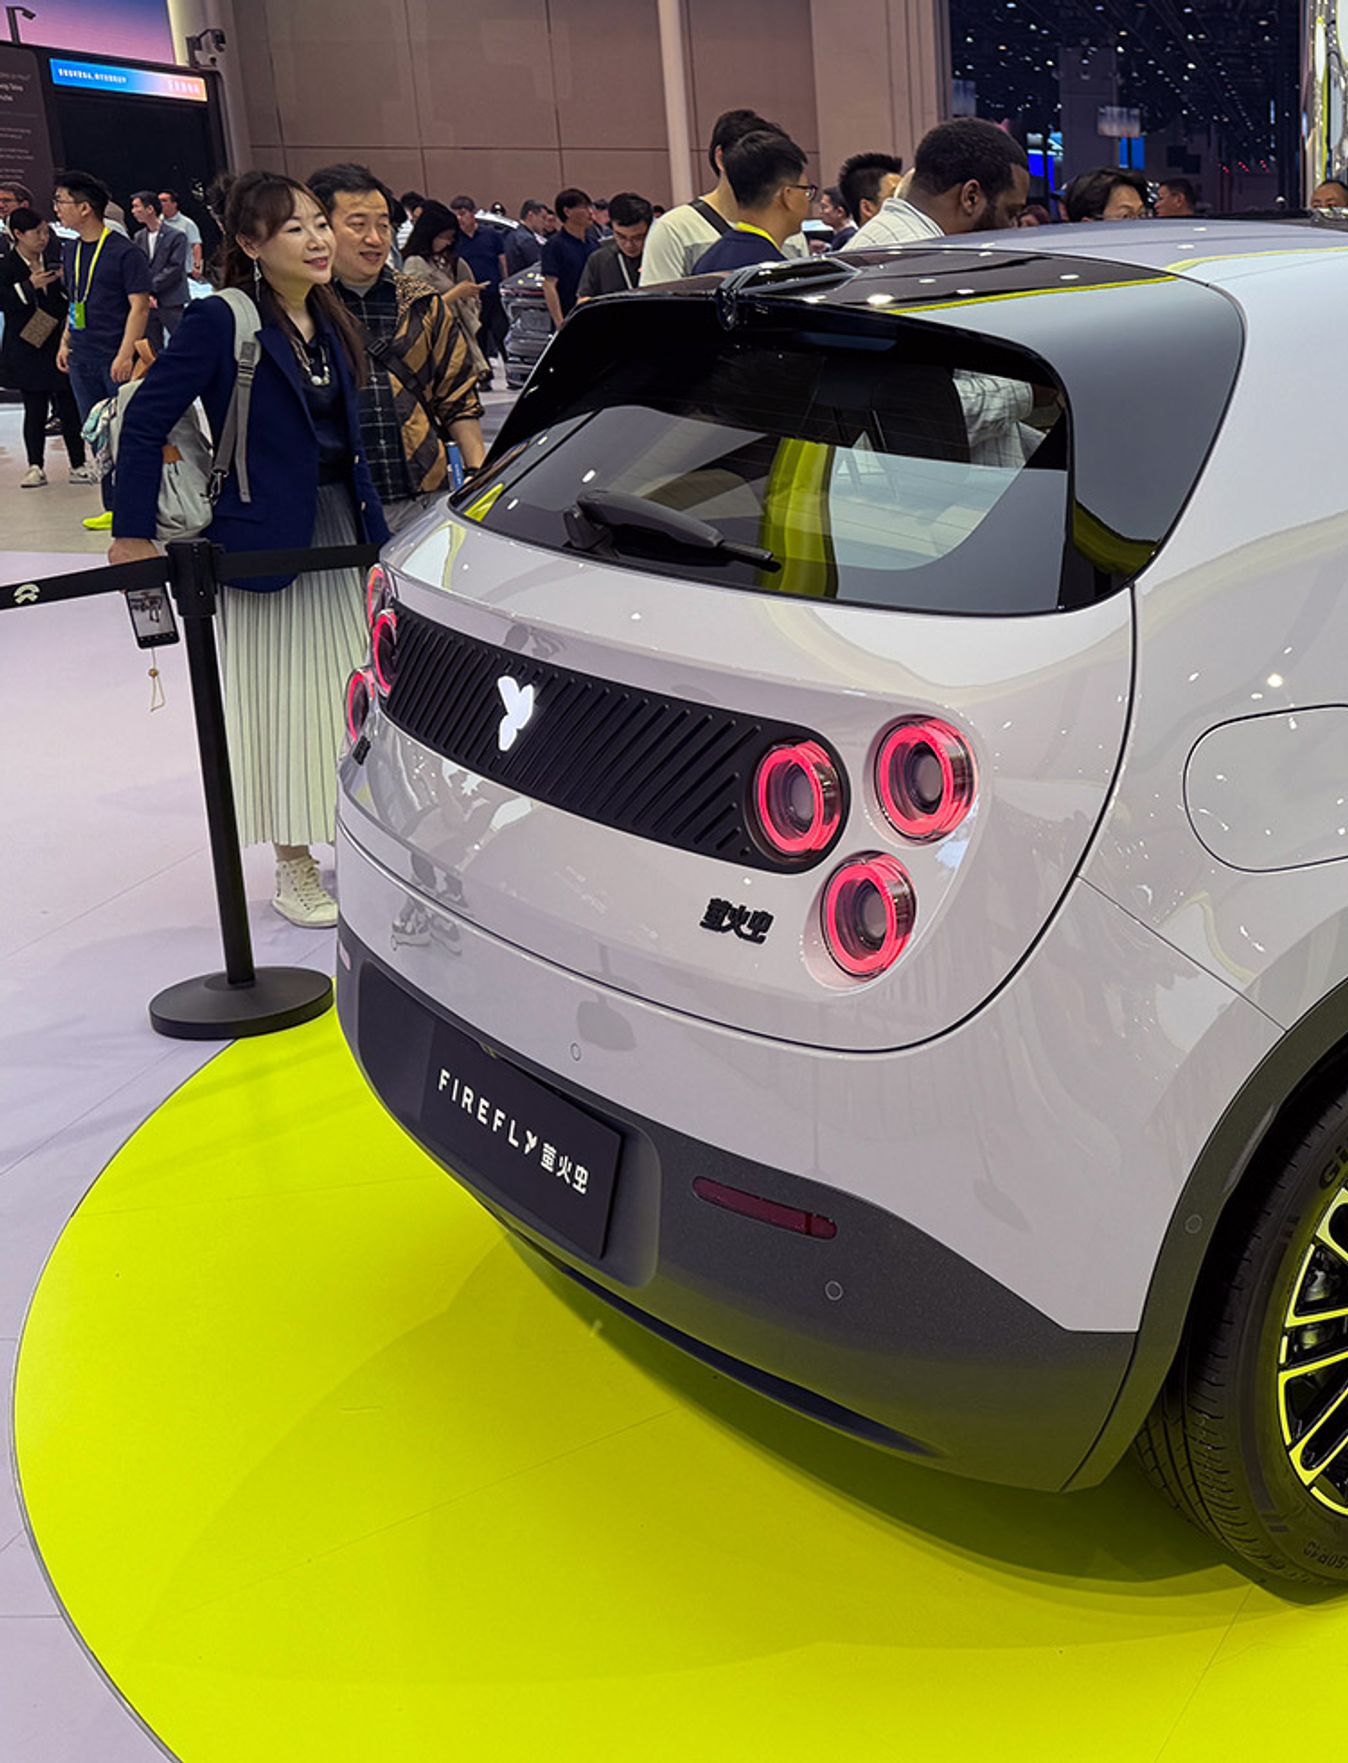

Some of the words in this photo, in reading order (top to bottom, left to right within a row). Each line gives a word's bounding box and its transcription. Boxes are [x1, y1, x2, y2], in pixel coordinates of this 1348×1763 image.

[699, 897, 775, 945] 萤火虫
[438, 1068, 538, 1154] FIREFLY
[540, 1142, 589, 1194] 萤火虫
